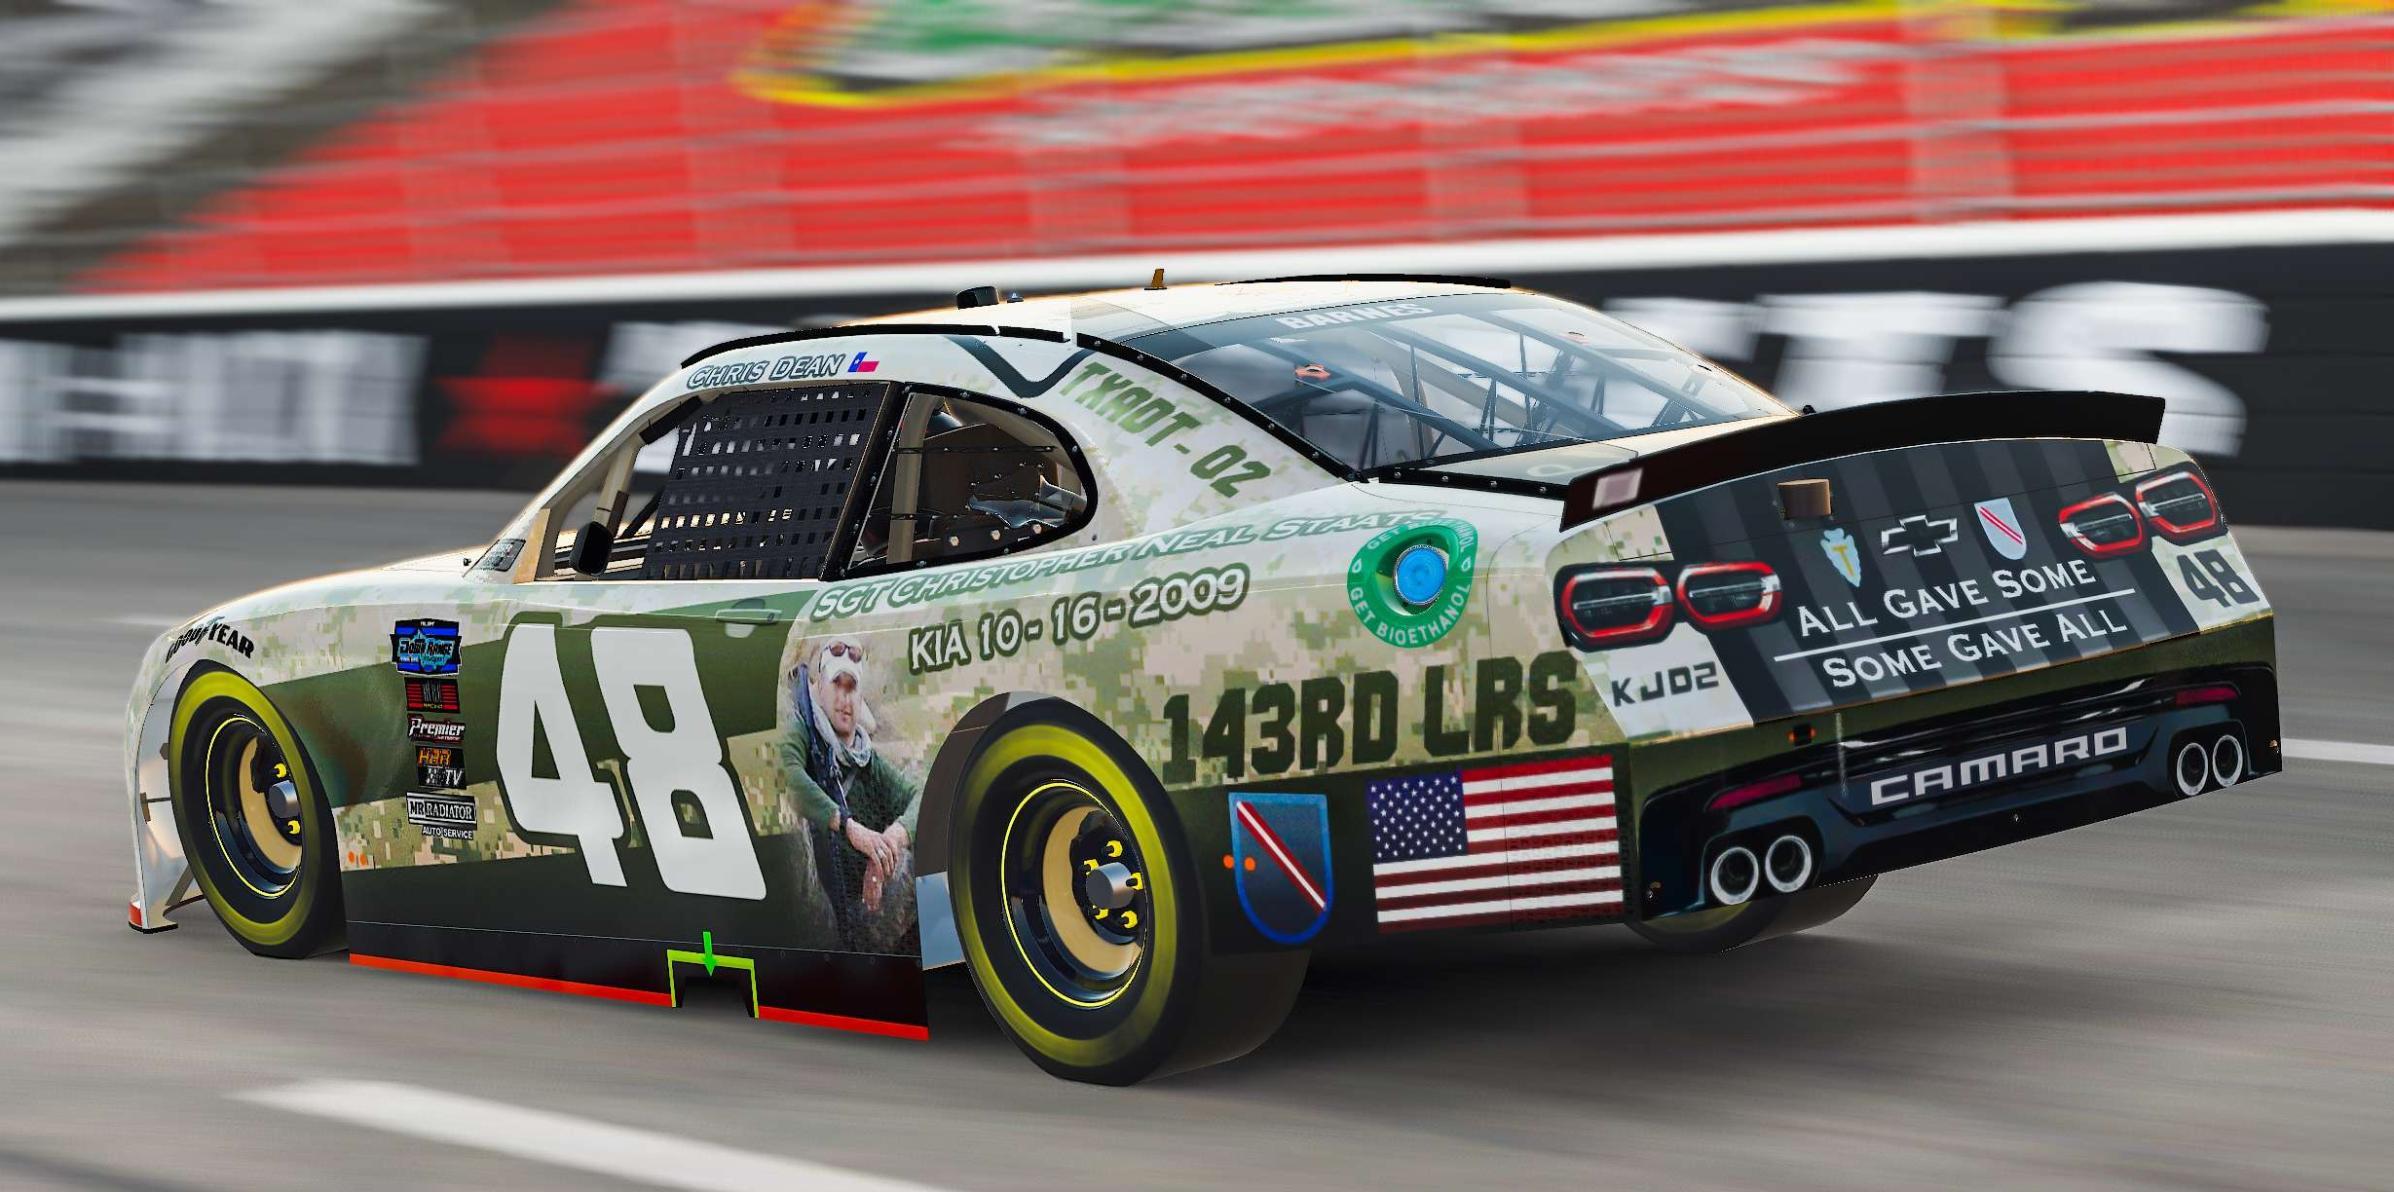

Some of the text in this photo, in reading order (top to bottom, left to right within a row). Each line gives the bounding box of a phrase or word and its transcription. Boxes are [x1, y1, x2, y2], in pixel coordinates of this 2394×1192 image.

[1275, 303, 1433, 329] BARNES
[687, 353, 846, 389] CHRIS DEAN
[810, 578, 893, 621] SGT
[888, 543, 1132, 608] CHRISTOPHER
[1136, 525, 1258, 559] NEAL
[2177, 549, 2260, 608] 48
[164, 615, 255, 664] GOODYEAR
[1350, 583, 1471, 646] GET BIOETHANOL
[909, 619, 972, 675] KIA
[408, 718, 466, 737] Premier
[1162, 650, 1578, 785] 143RD LRS
[496, 622, 767, 901] 48
[1871, 727, 2127, 806] CAMARO
[422, 826, 474, 840] AUTO SERVICE
[425, 803, 473, 820] RADIATOR
